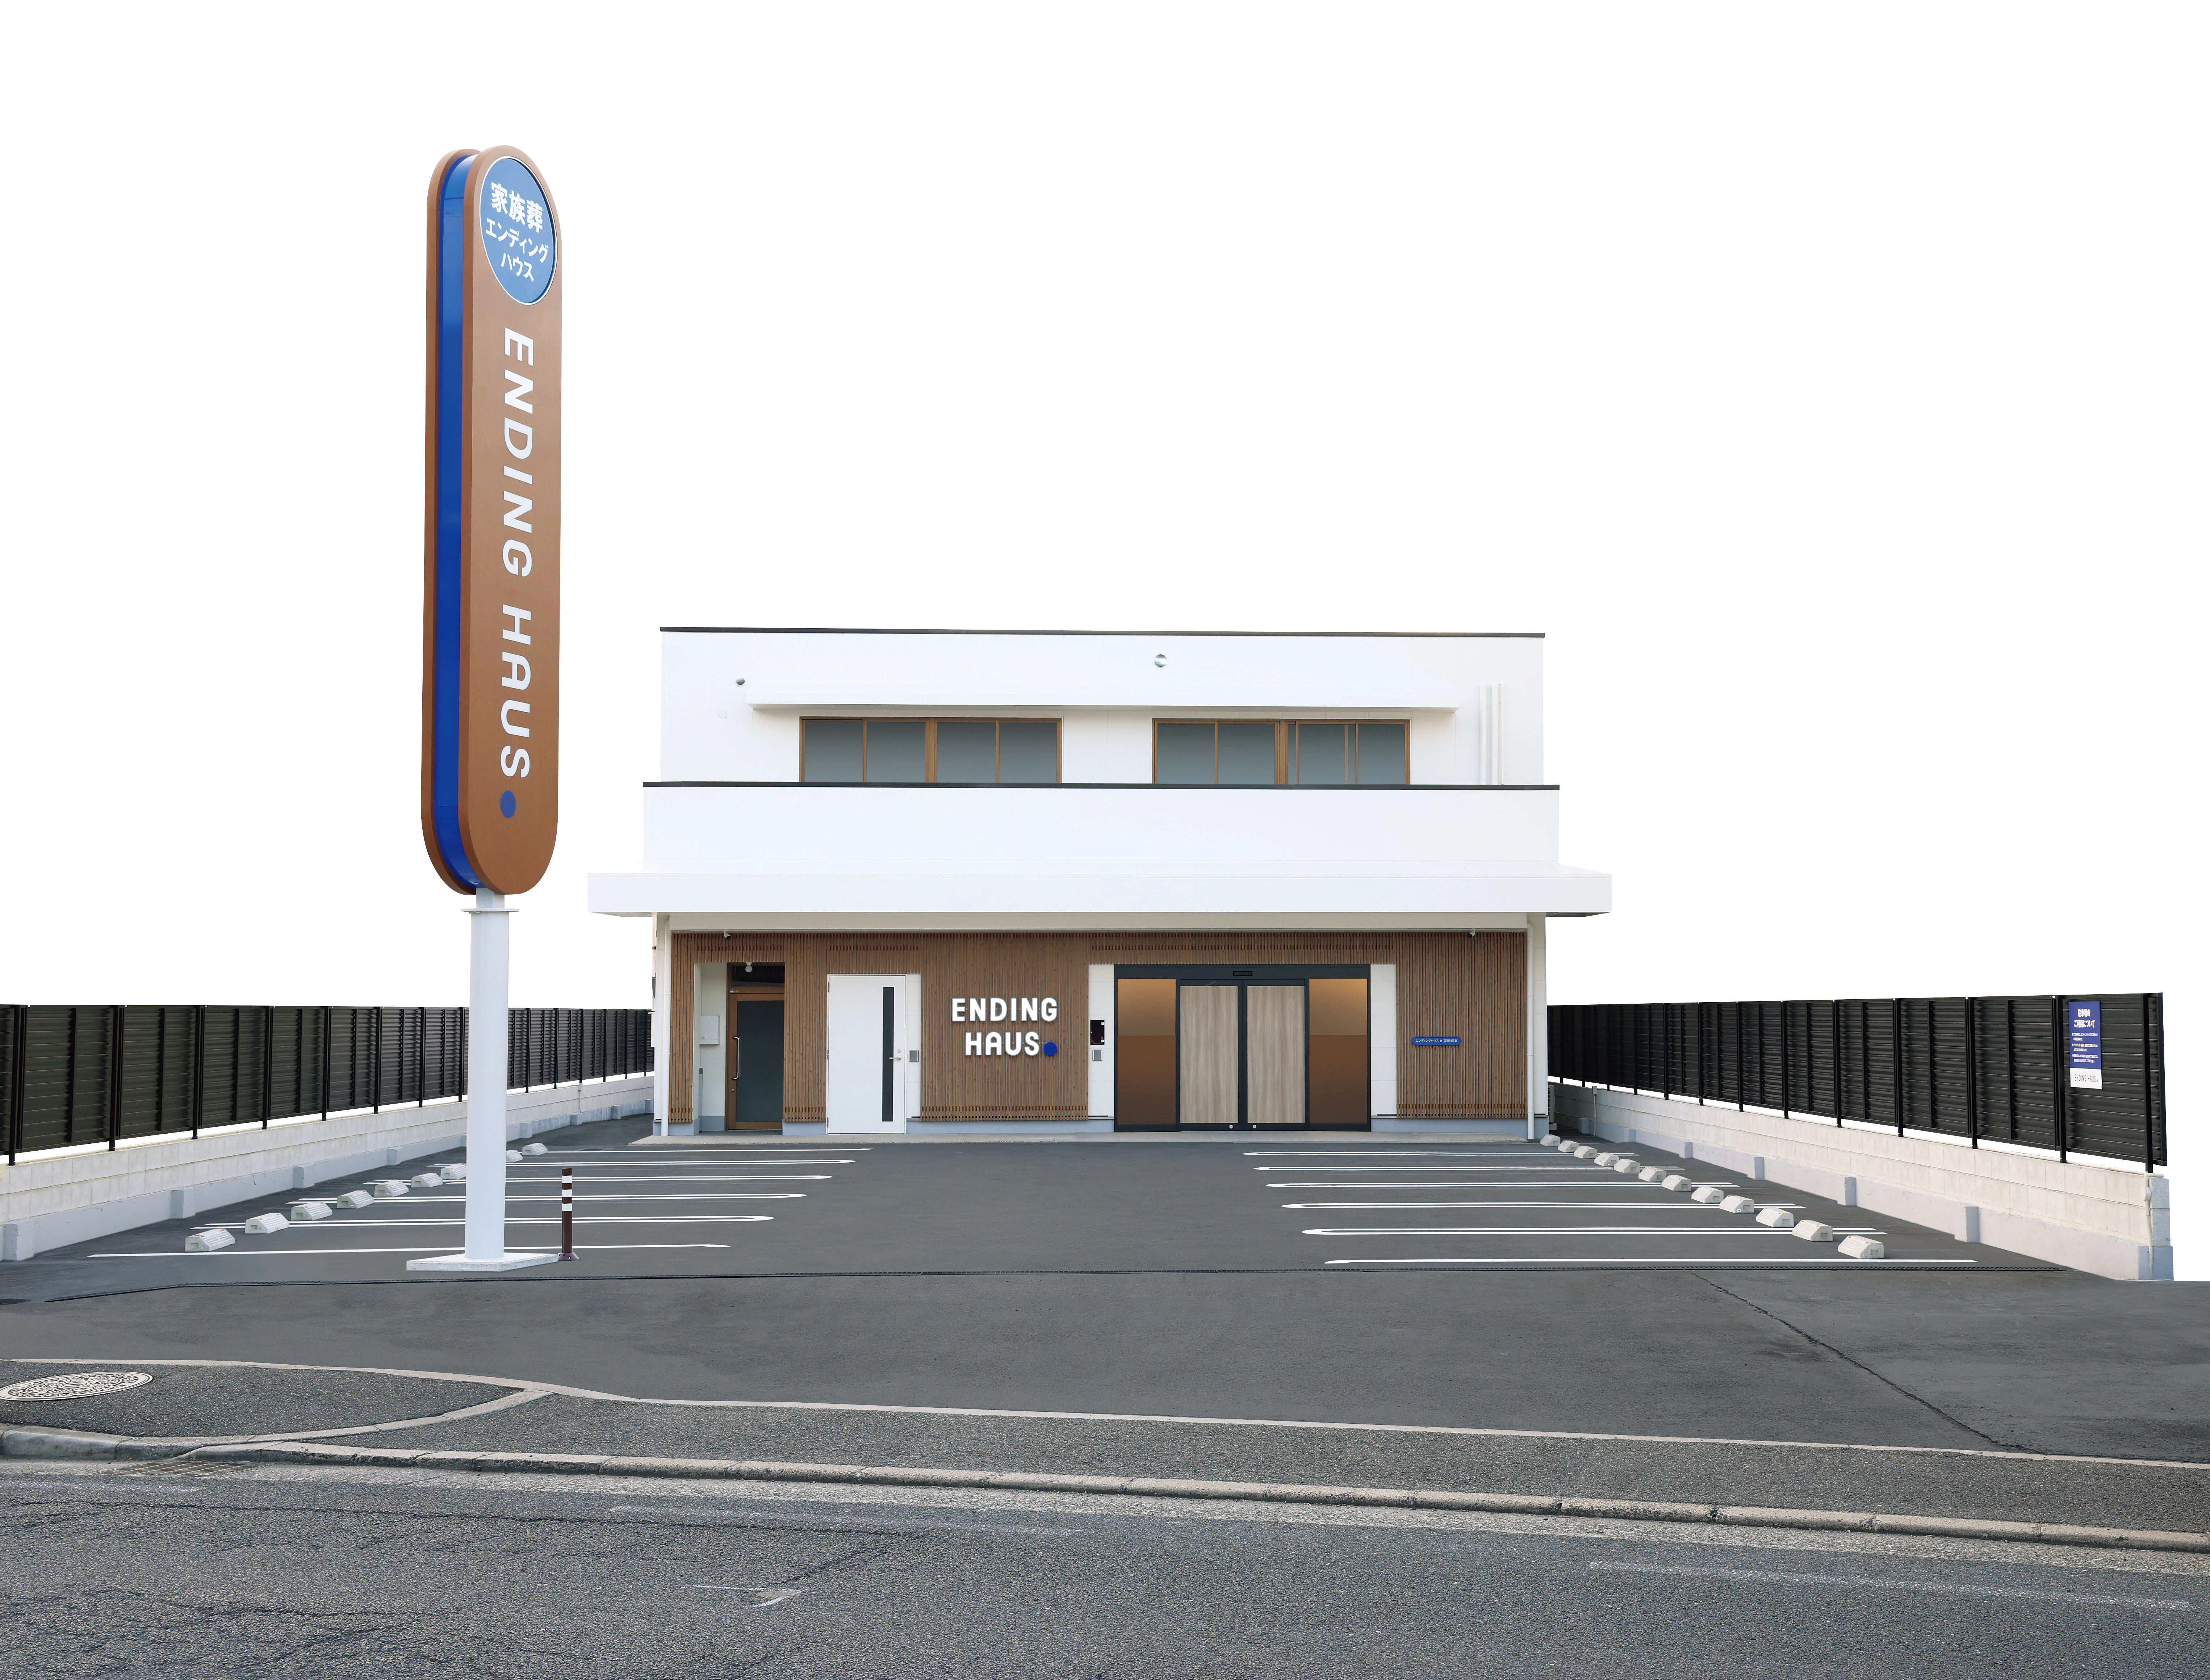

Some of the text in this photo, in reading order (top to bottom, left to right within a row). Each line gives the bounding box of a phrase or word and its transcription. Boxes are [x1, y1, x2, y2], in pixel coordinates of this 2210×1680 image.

[491, 182, 543, 233] 家族葬
[486, 218, 548, 263] エンディング
[501, 252, 534, 282] ハウス
[502, 327, 534, 577] ENDING
[951, 997, 1058, 1022] ENDING
